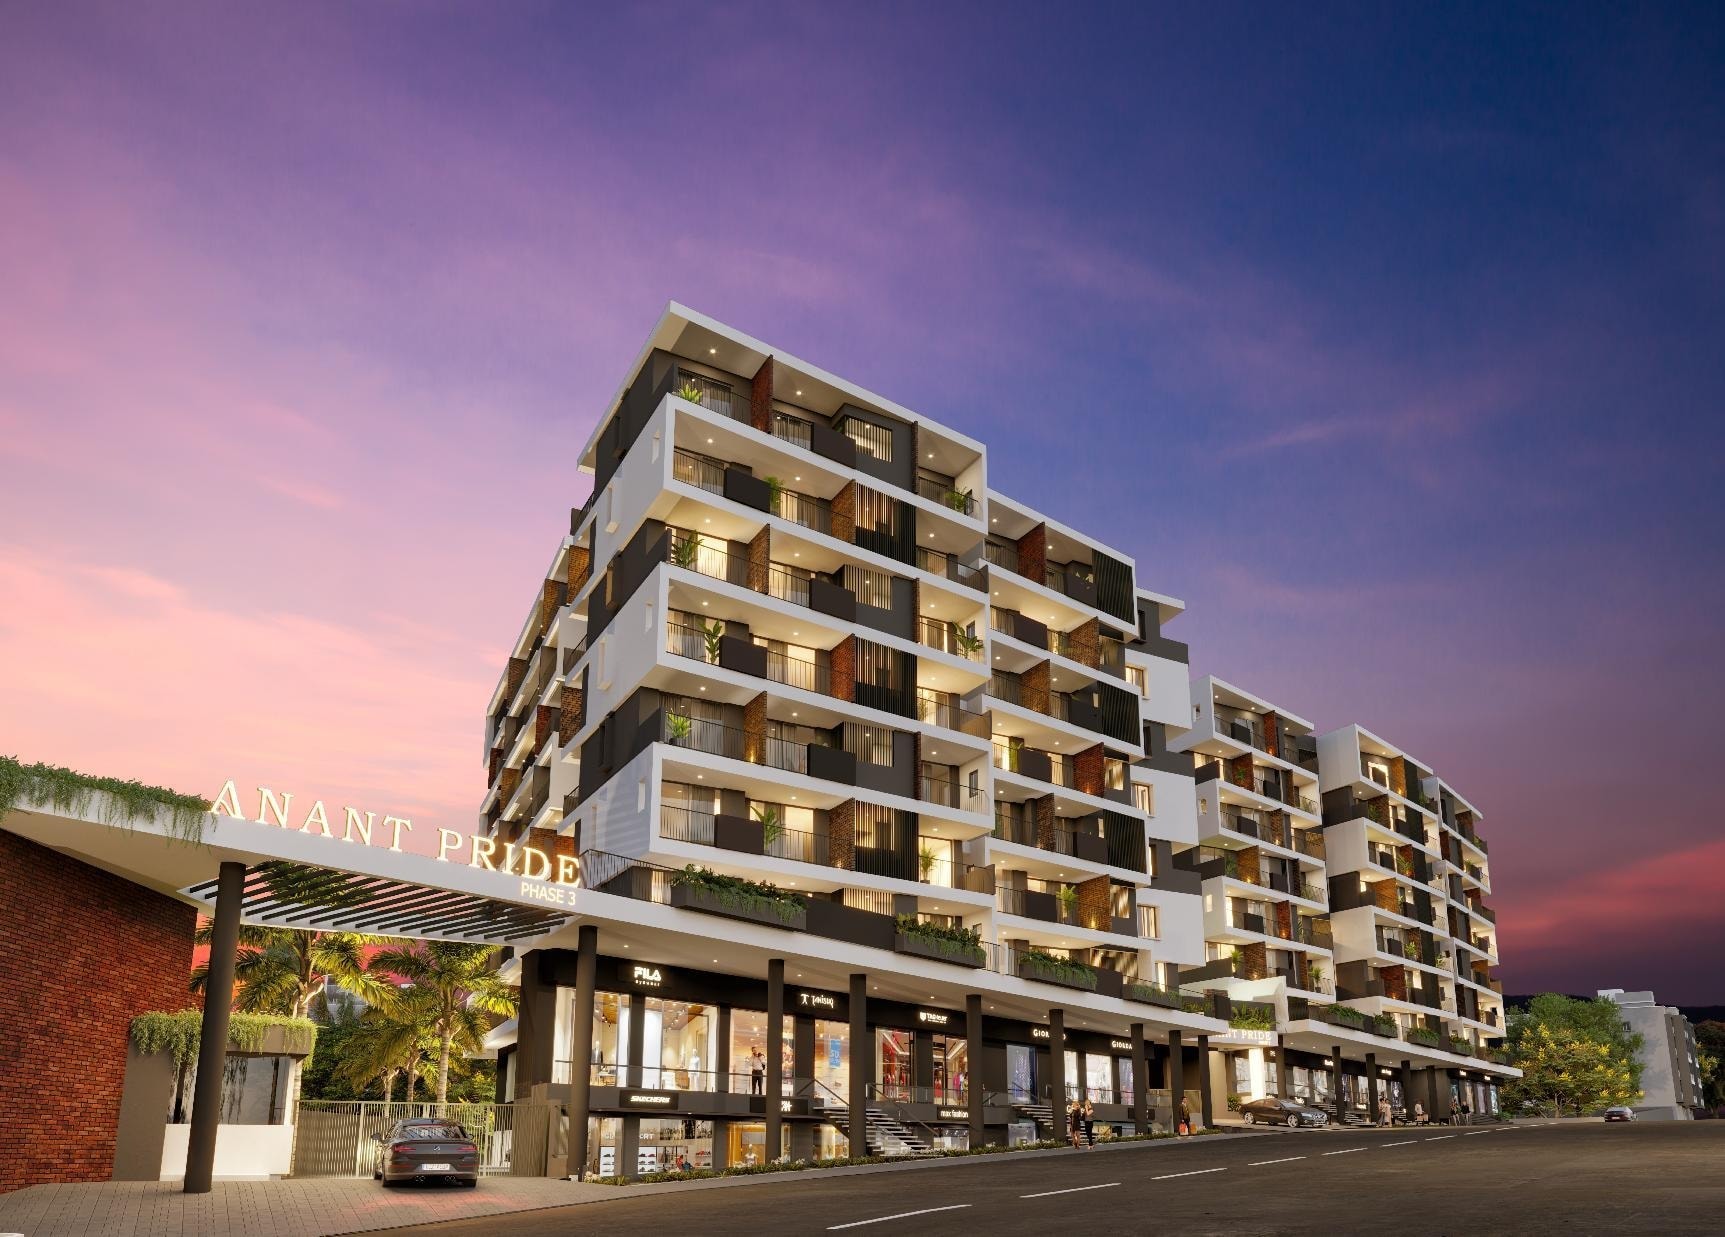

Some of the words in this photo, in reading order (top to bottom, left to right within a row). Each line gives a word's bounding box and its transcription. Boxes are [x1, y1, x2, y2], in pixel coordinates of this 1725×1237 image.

[209, 777, 412, 853] ANANT
[437, 827, 581, 888] PRIDE
[520, 881, 566, 904] PHASE
[568, 891, 576, 906] 3
[634, 966, 662, 981] FILA
